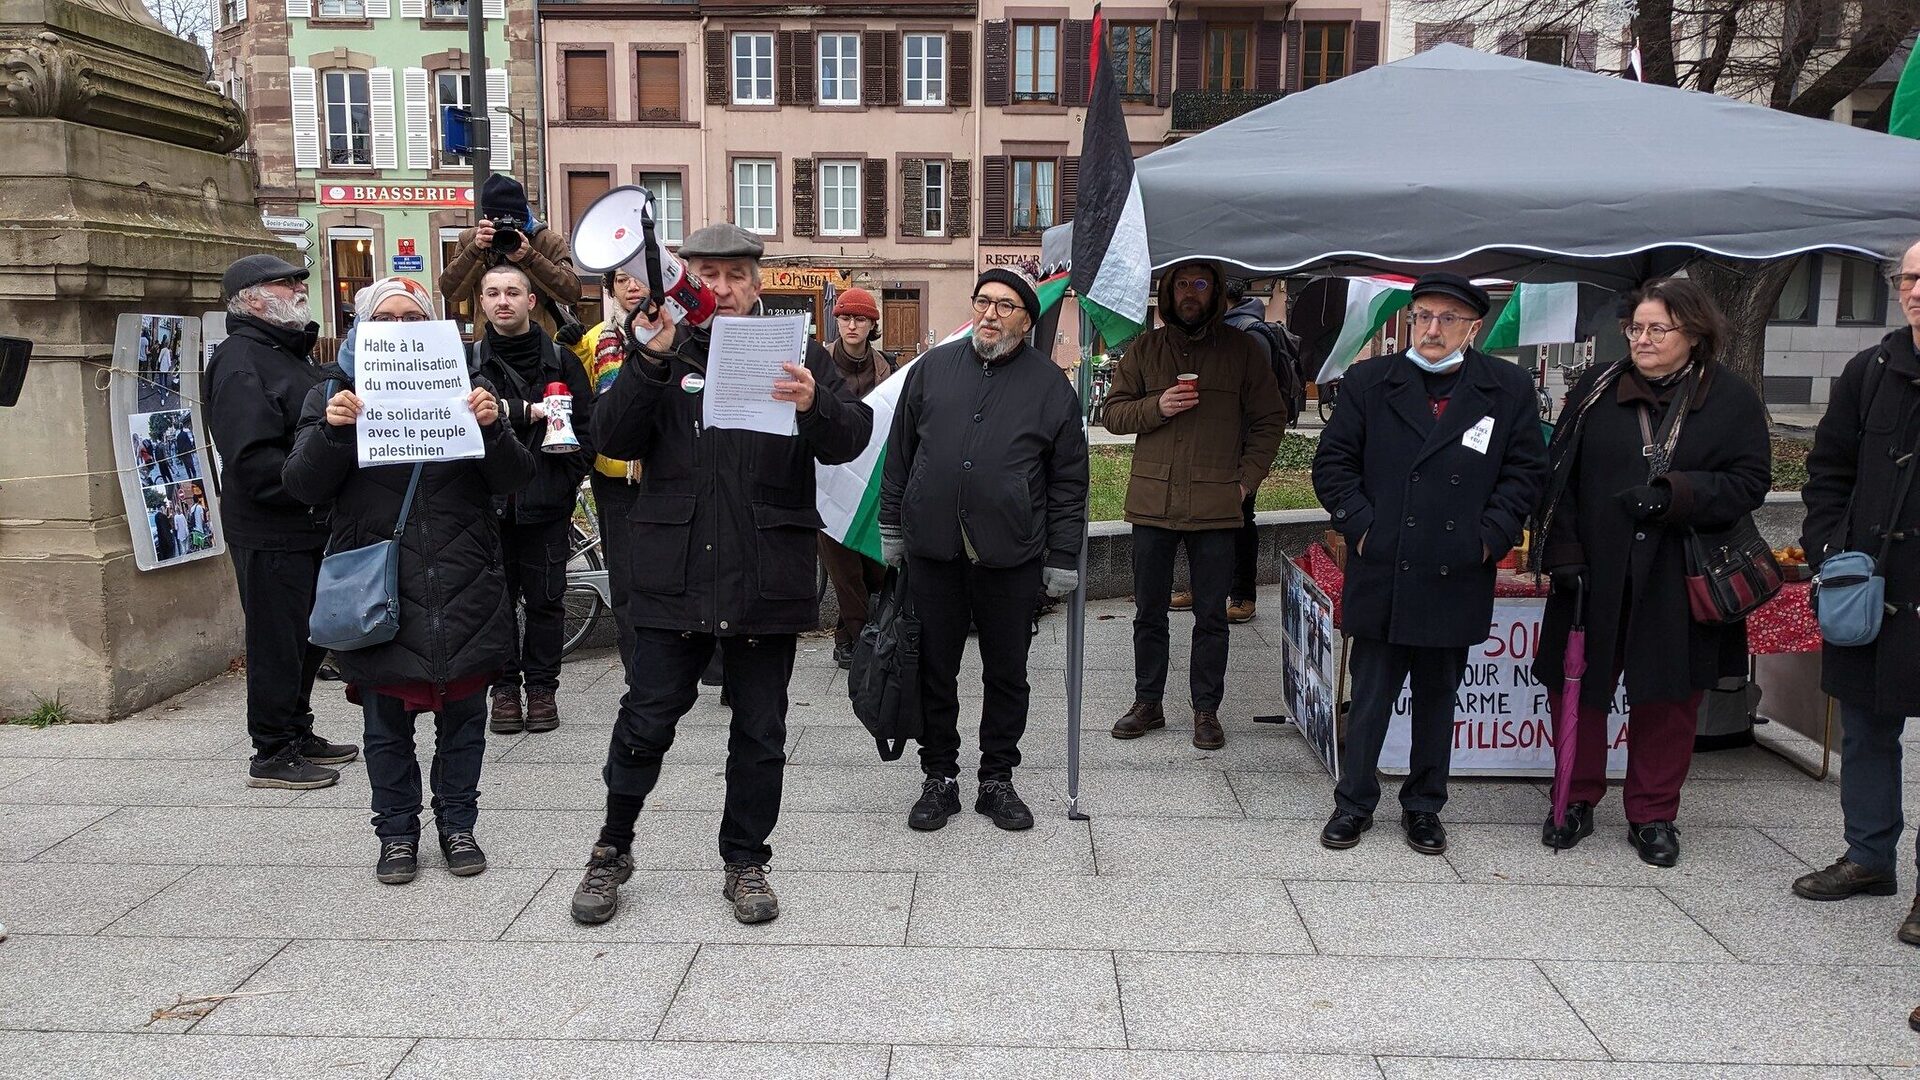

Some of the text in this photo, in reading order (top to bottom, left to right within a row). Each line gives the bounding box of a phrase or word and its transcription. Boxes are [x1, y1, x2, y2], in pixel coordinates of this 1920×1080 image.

[353, 187, 457, 201] BRASSERIE
[364, 339, 424, 352] Halte à la
[364, 357, 458, 372] criminalisation
[364, 376, 462, 391] du mouvement
[366, 406, 451, 421] de solidarité
[368, 425, 466, 441] avec le peuple
[369, 444, 444, 460] palestinien
[1463, 663, 1499, 686] OUR
